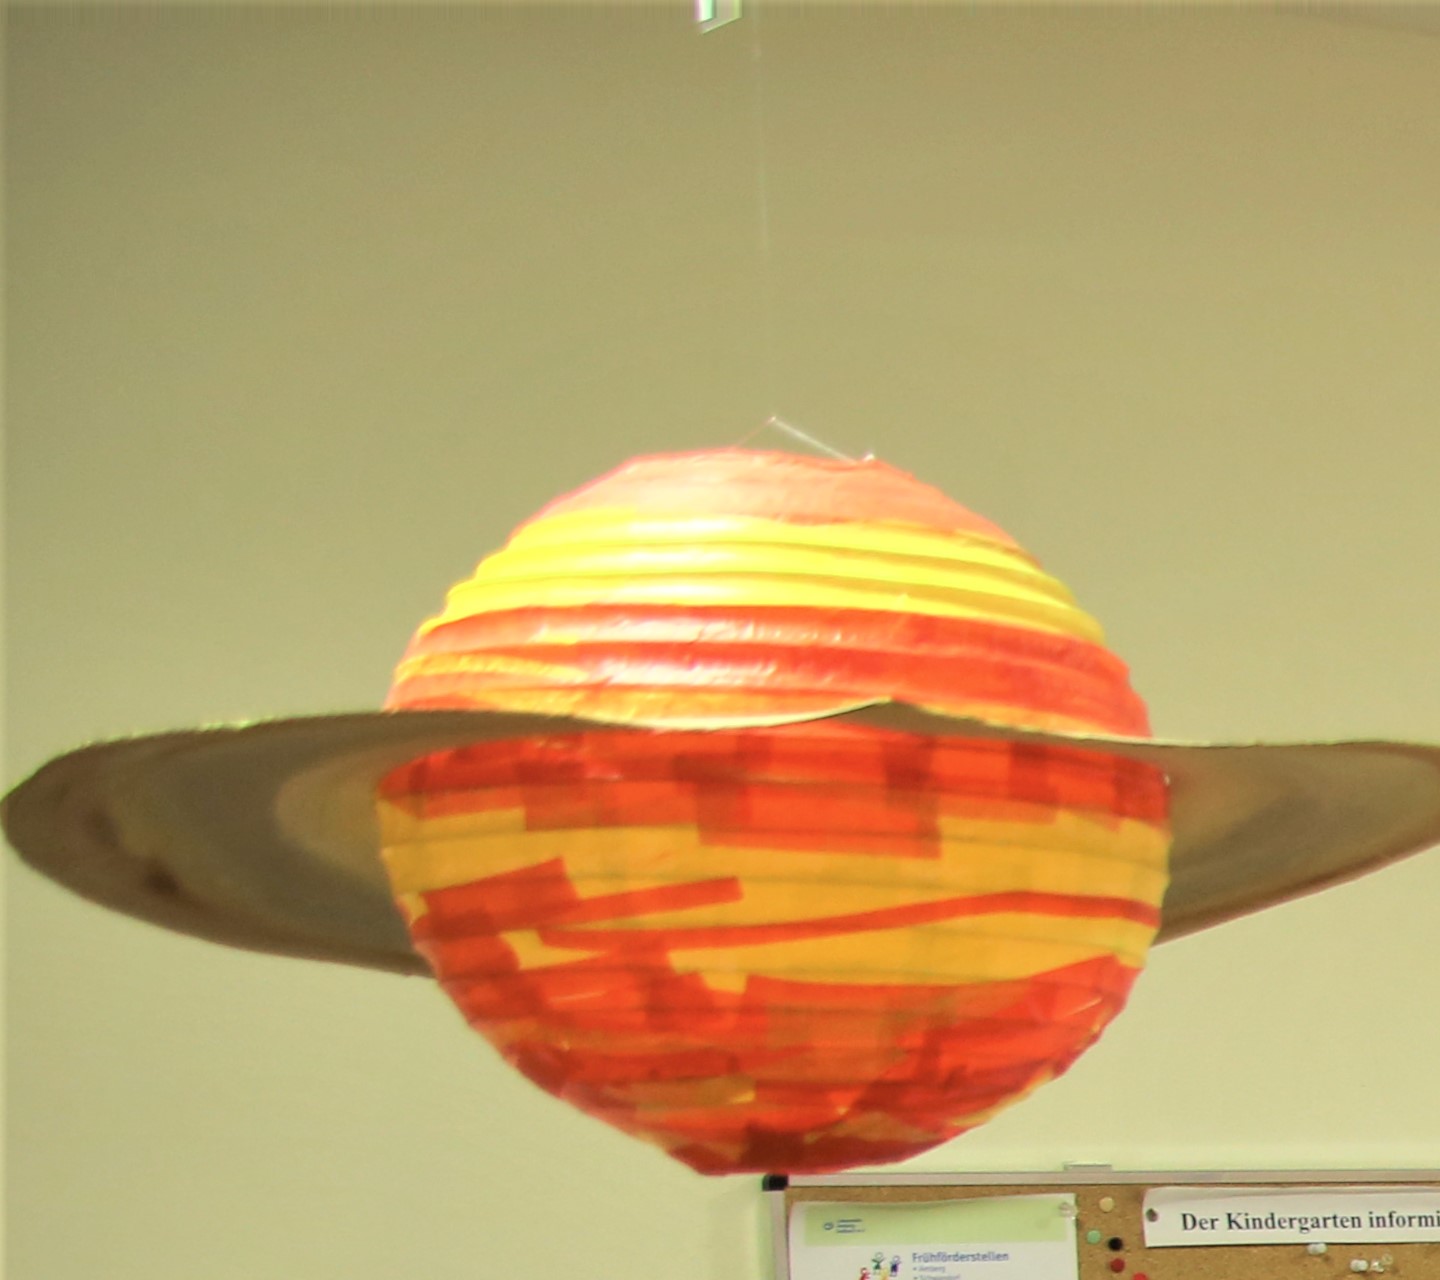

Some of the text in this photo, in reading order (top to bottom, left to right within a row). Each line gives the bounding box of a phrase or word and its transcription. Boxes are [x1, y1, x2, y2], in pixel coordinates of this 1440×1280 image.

[1181, 1212, 1220, 1232] Der
[1227, 1211, 1363, 1233] Kindergarten
[912, 1252, 1009, 1263] Frühförderstellen
